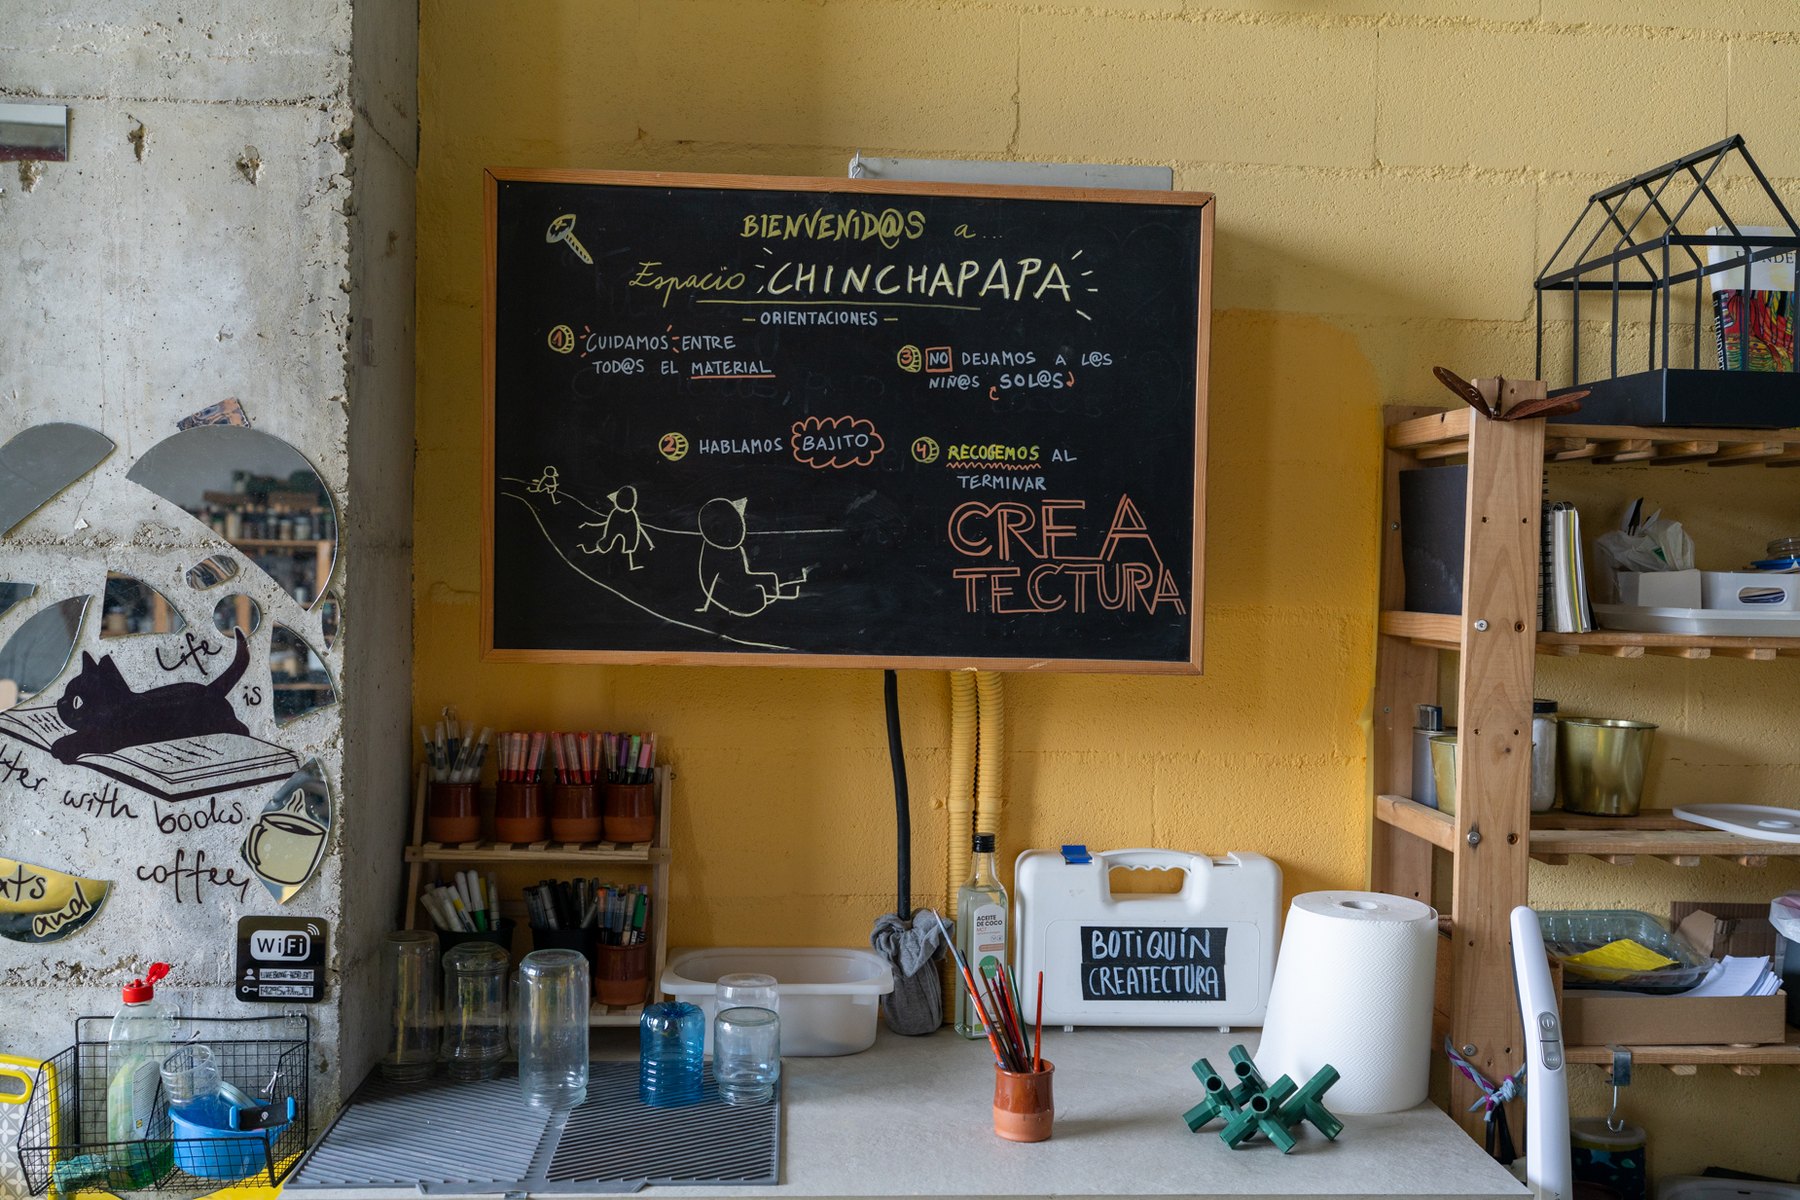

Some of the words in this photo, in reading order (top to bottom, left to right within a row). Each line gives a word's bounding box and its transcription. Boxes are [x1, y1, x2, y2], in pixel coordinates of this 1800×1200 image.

[740, 208, 926, 249] BIENVENID@S
[629, 261, 745, 308] Espacio
[767, 258, 1071, 302] CHINCHAPAPA
[760, 311, 878, 326] ORIENTACIONES
[586, 333, 668, 352] CUIDAMOS
[682, 335, 736, 350] ENTRE
[592, 357, 645, 375] TOD@S
[661, 361, 678, 375] EL
[692, 360, 772, 375] MATERIAL
[930, 352, 948, 365] NO
[962, 351, 1036, 366] DEJAMOS
[1055, 354, 1067, 365] A
[1081, 352, 1113, 367] L@S
[1000, 370, 1064, 389] SOL@S
[699, 437, 783, 454] HABLAMOS
[803, 433, 869, 451] BAJITO
[948, 443, 1040, 461] RECOGEMOS
[1052, 448, 1077, 462] AL
[957, 473, 1046, 491] TERMINAR
[948, 493, 1162, 562] CREA
[953, 562, 1186, 615] TECTURA
[243, 686, 262, 706] is
[64, 783, 138, 818] with
[34, 881, 89, 935] and
[257, 938, 303, 954] WiFi
[1089, 964, 1219, 999] CREATECTURA
